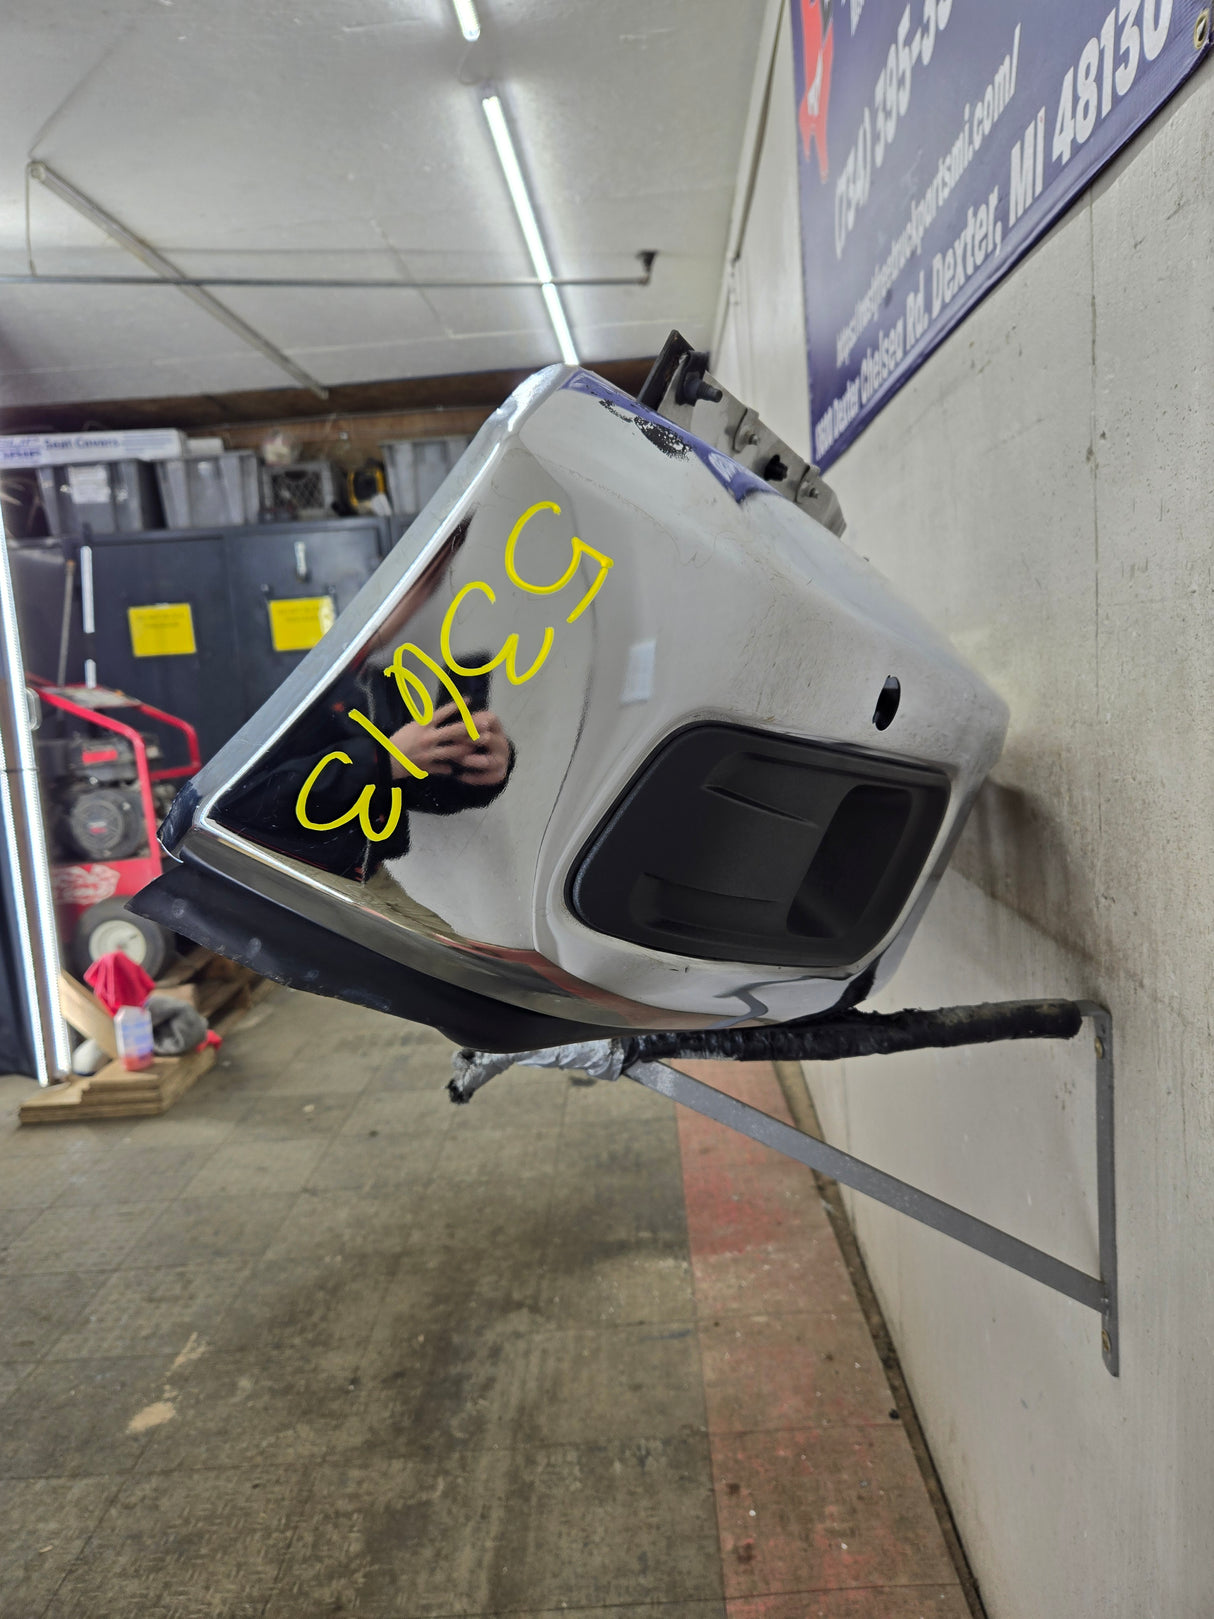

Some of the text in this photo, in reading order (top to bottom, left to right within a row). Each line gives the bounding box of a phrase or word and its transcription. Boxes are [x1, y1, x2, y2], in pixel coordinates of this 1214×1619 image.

[861, 317, 904, 404] Chelsea
[906, 269, 929, 351] Rd.
[932, 185, 1002, 320] Dexter,
[1008, 105, 1046, 228] MI
[295, 501, 614, 842] 53613
